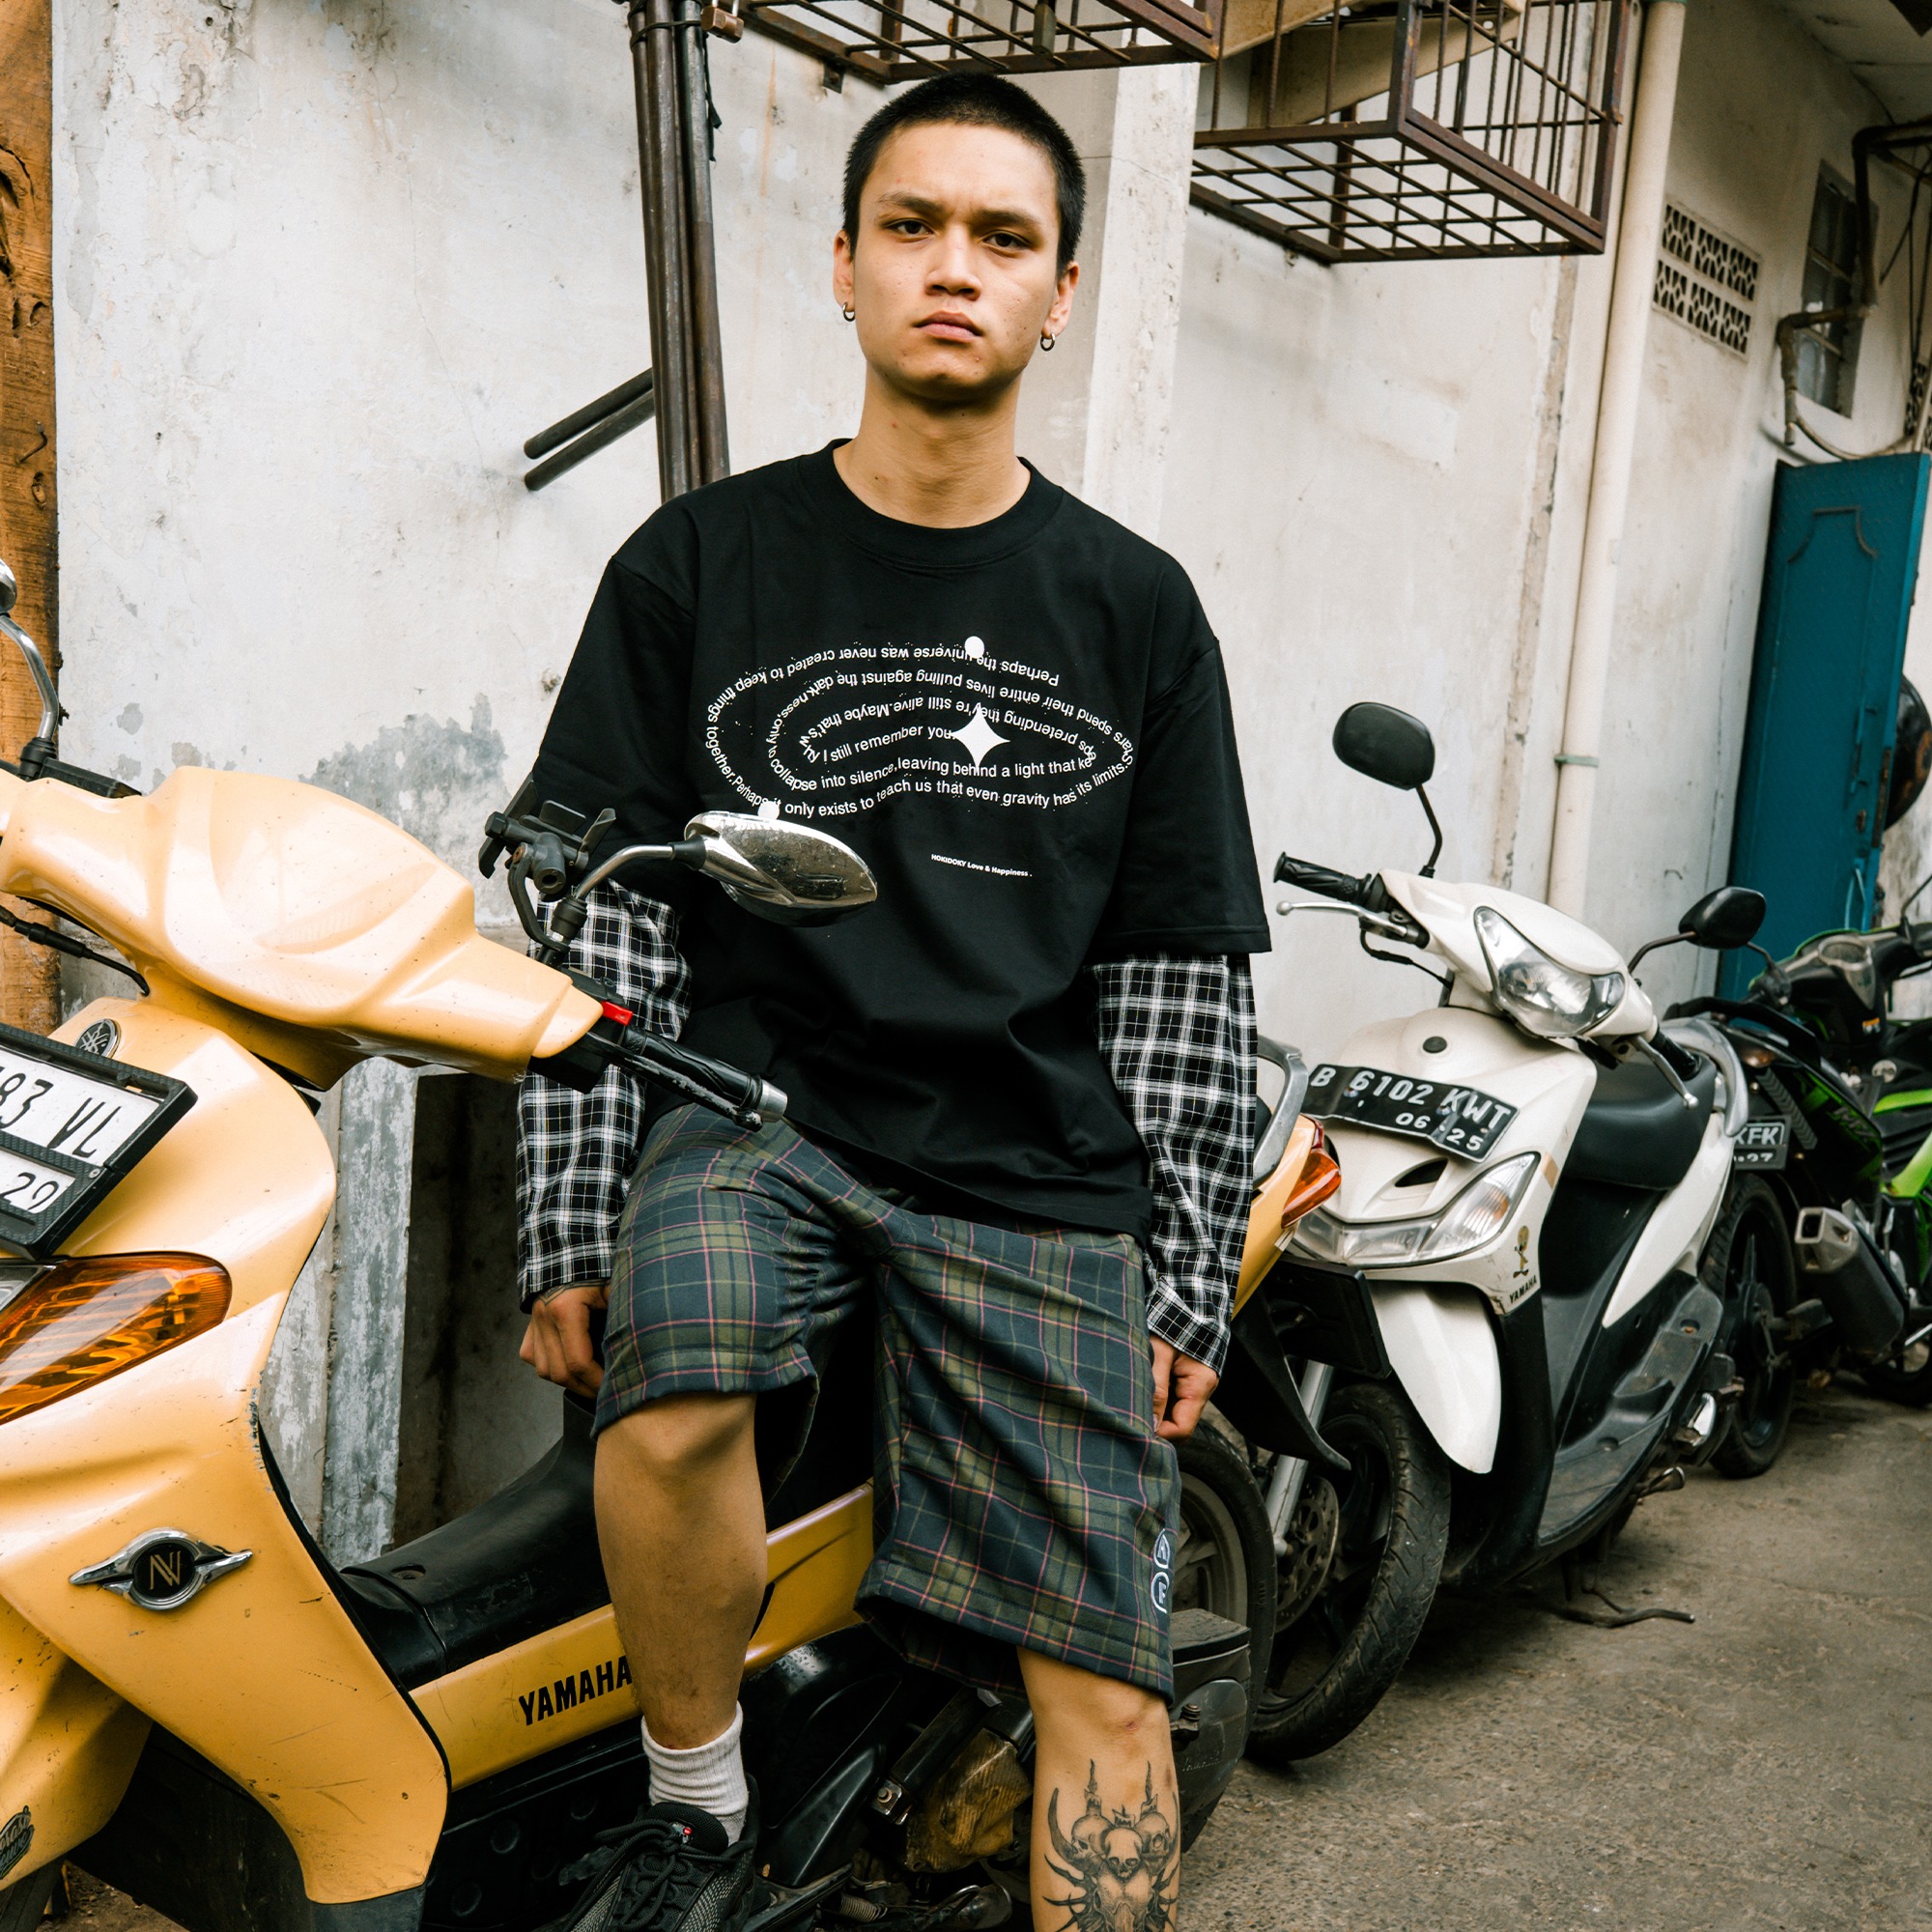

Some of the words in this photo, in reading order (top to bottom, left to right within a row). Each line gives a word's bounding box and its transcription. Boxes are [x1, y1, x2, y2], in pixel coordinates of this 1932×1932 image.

[838, 647, 876, 660] never
[881, 647, 909, 659] was
[787, 650, 836, 676] created
[977, 656, 997, 671] the
[735, 671, 768, 692] keep
[770, 668, 784, 679] to
[837, 673, 858, 687] the
[862, 669, 913, 686] against
[916, 669, 963, 687] pulling
[1001, 661, 1060, 687] Perhaps
[966, 679, 995, 698] lives
[1000, 687, 1040, 703] entire
[707, 687, 736, 723] things
[928, 696, 952, 710] still
[1043, 696, 1074, 717] their
[808, 713, 842, 738] that's
[1004, 710, 1079, 745] pretending
[1076, 709, 1113, 735] spend
[854, 725, 923, 753] remember
[768, 744, 778, 758] to
[799, 735, 820, 763] why
[823, 750, 828, 762] I
[830, 743, 852, 762] still
[1077, 740, 1096, 770] keeps
[770, 758, 817, 791] collapse
[952, 761, 997, 778] behind
[1001, 767, 1010, 778] a
[1015, 763, 1044, 779] light
[1048, 758, 1075, 774] that
[821, 775, 846, 789] into
[876, 779, 911, 802] teach
[915, 781, 932, 792] us
[936, 780, 963, 794] that
[1076, 781, 1093, 796] its
[966, 785, 999, 802] even
[1003, 792, 1050, 810] gravity
[1054, 790, 1077, 807] has
[784, 801, 814, 819] only
[818, 801, 858, 817] exists
[860, 797, 874, 810] to
[967, 862, 984, 871] Love
[991, 867, 1029, 876] Happiness
[1310, 1067, 1336, 1087] B
[1350, 1070, 1434, 1105] 6102
[1441, 1088, 1512, 1129] KWT
[0, 1066, 53, 1128] 83
[47, 1096, 122, 1158] VL
[1508, 1275, 1538, 1304] YAMAHA
[518, 1655, 633, 1726] YAMAHA
